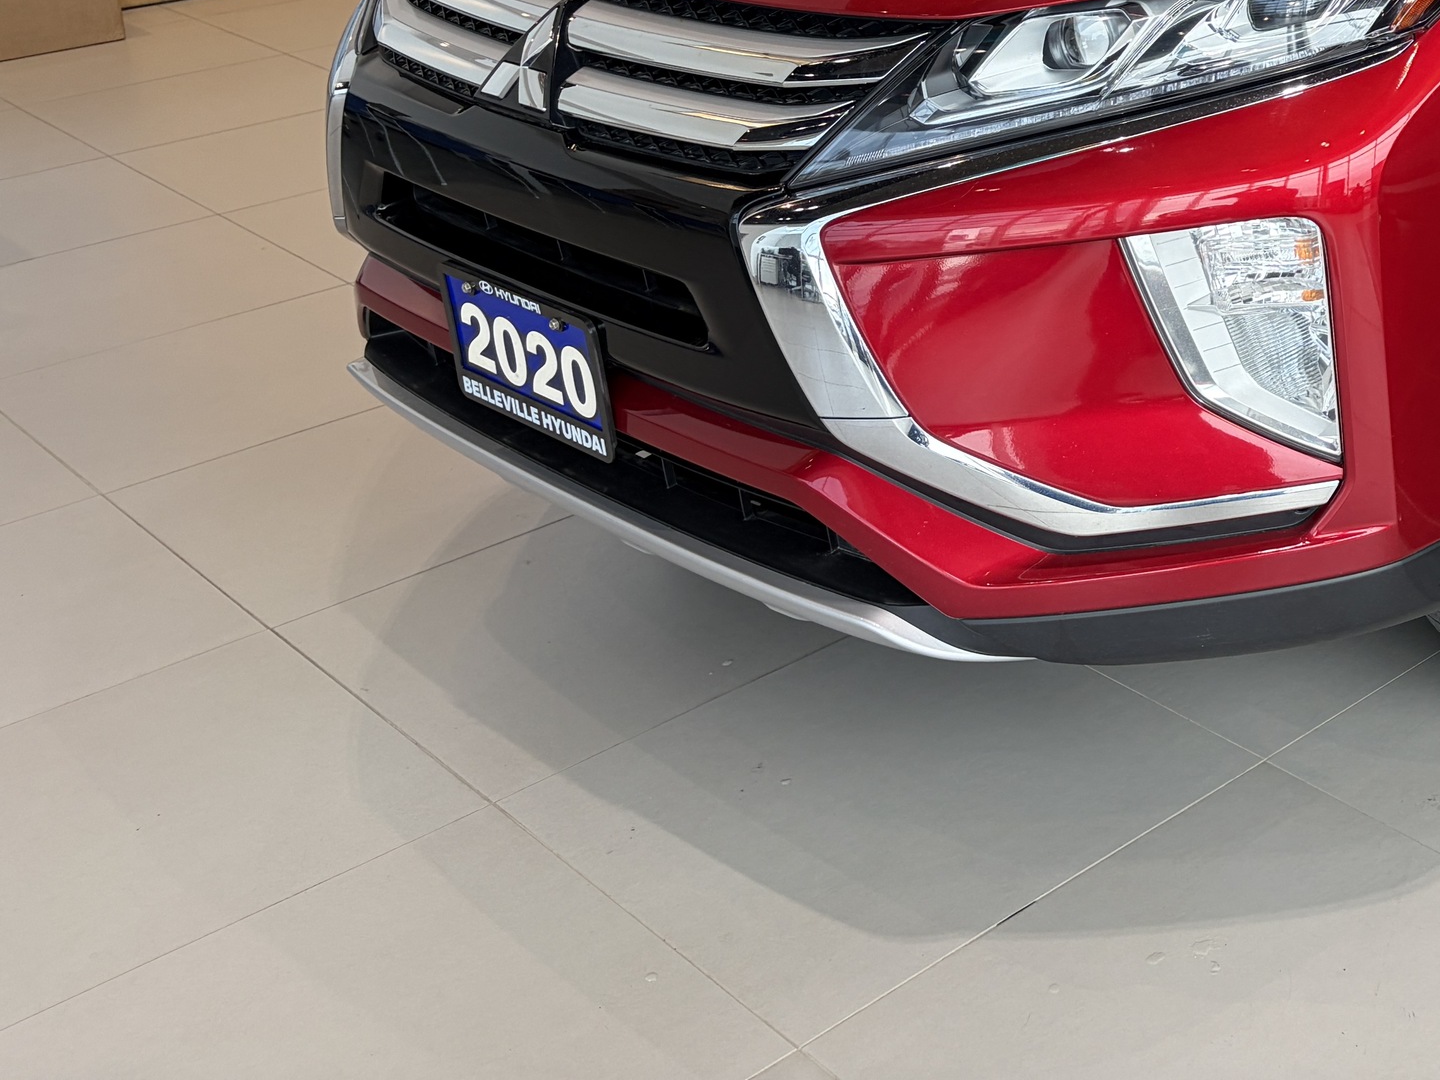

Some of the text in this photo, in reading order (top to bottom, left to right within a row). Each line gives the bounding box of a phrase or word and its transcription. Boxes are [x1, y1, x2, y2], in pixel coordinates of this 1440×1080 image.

[495, 287, 541, 315] HYUNDAI
[460, 302, 597, 418] 2020
[462, 376, 607, 457] BELLEVILLE HYUNDAI
